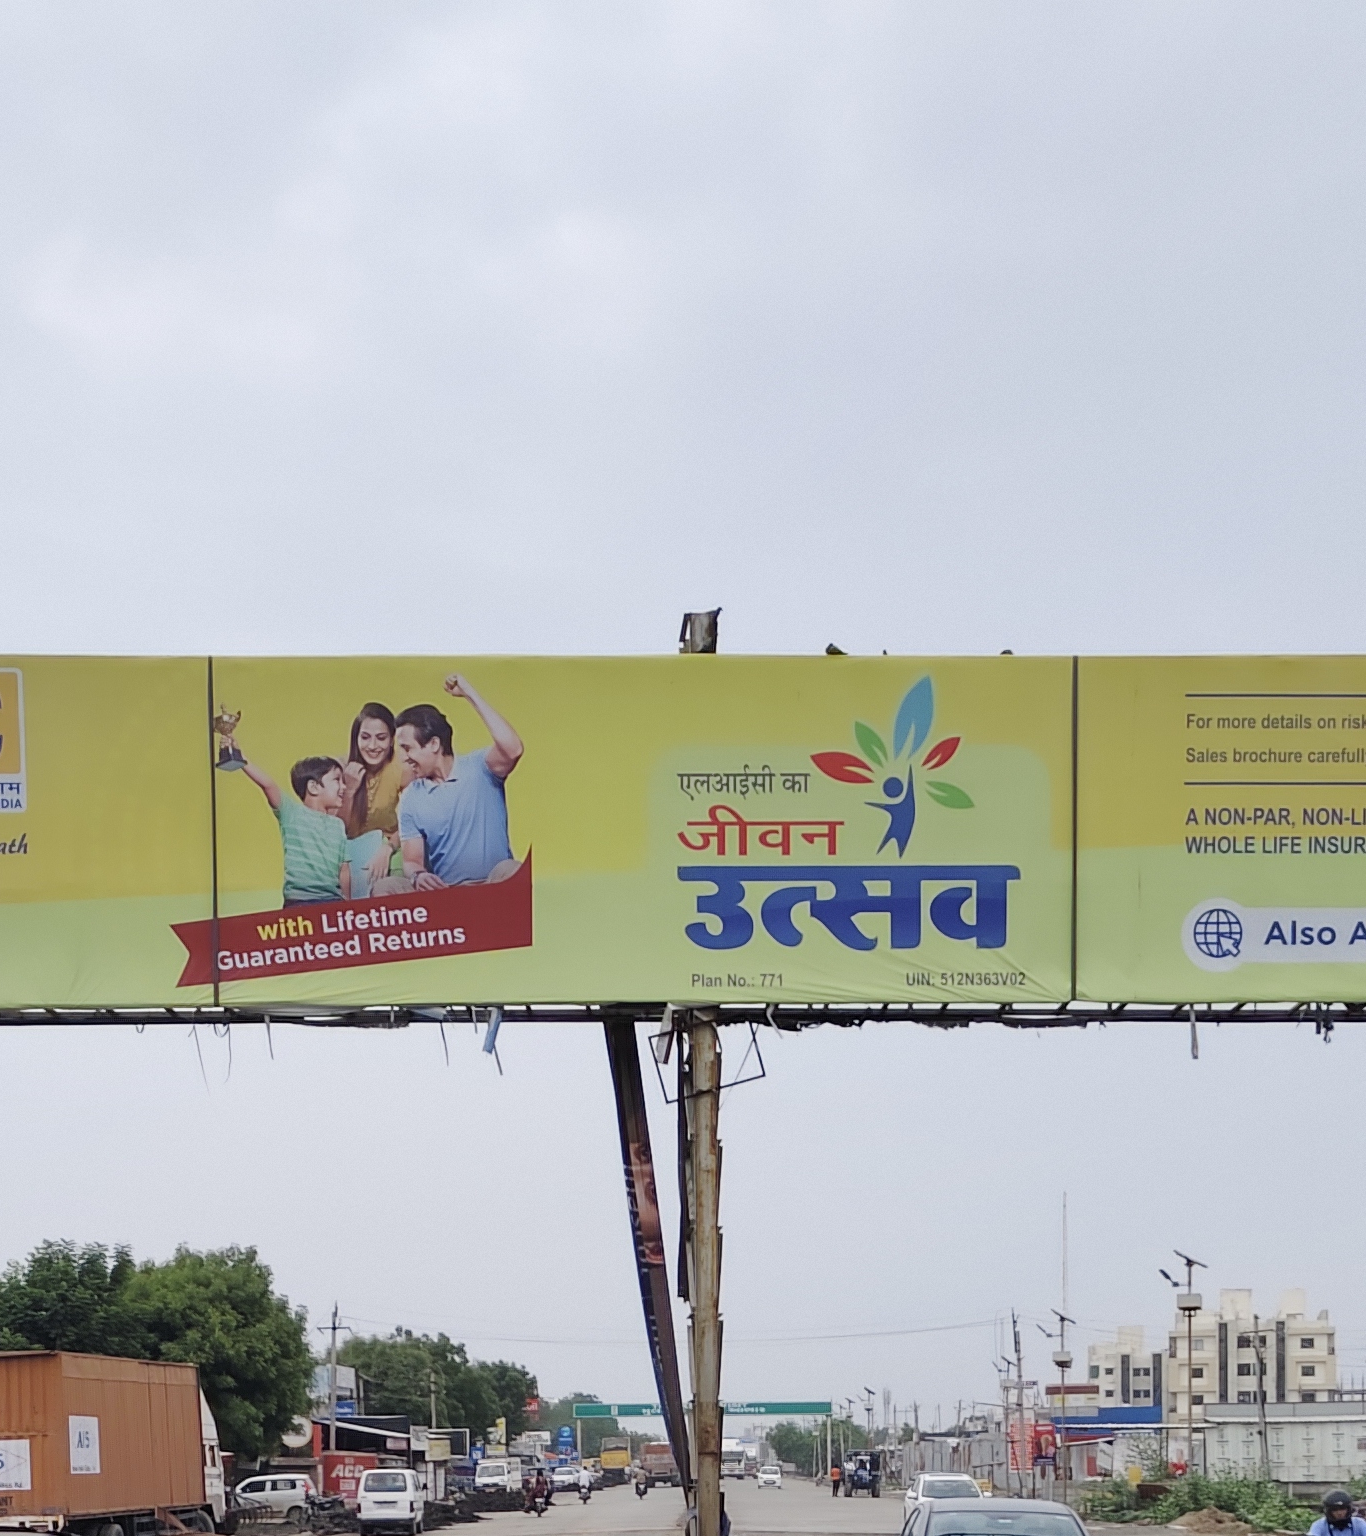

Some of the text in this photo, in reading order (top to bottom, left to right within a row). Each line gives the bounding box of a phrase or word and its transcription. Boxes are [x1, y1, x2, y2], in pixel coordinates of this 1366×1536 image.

[1186, 713, 1213, 730] For
[1217, 717, 1256, 730] more
[1261, 713, 1312, 730] details
[1317, 717, 1337, 730] on
[1185, 748, 1227, 763] Sales
[1233, 748, 1302, 763] brochure
[677, 764, 811, 801] एलआईसी का
[1185, 808, 1199, 826] A
[1204, 808, 1296, 829] NON-PAR,
[677, 804, 845, 856] जीवन
[1185, 836, 1256, 854] WHOLE
[1262, 836, 1302, 854] LIFE
[677, 864, 1021, 952] उत्सव
[256, 906, 428, 941] with Lifetime
[1264, 920, 1337, 946] Also
[217, 927, 466, 971] Guaranteed Returns
[691, 973, 722, 988] Plan
[759, 973, 784, 988] 771
[906, 972, 1026, 987] UIN: 512N363V02
[330, 1464, 364, 1478] ACC
